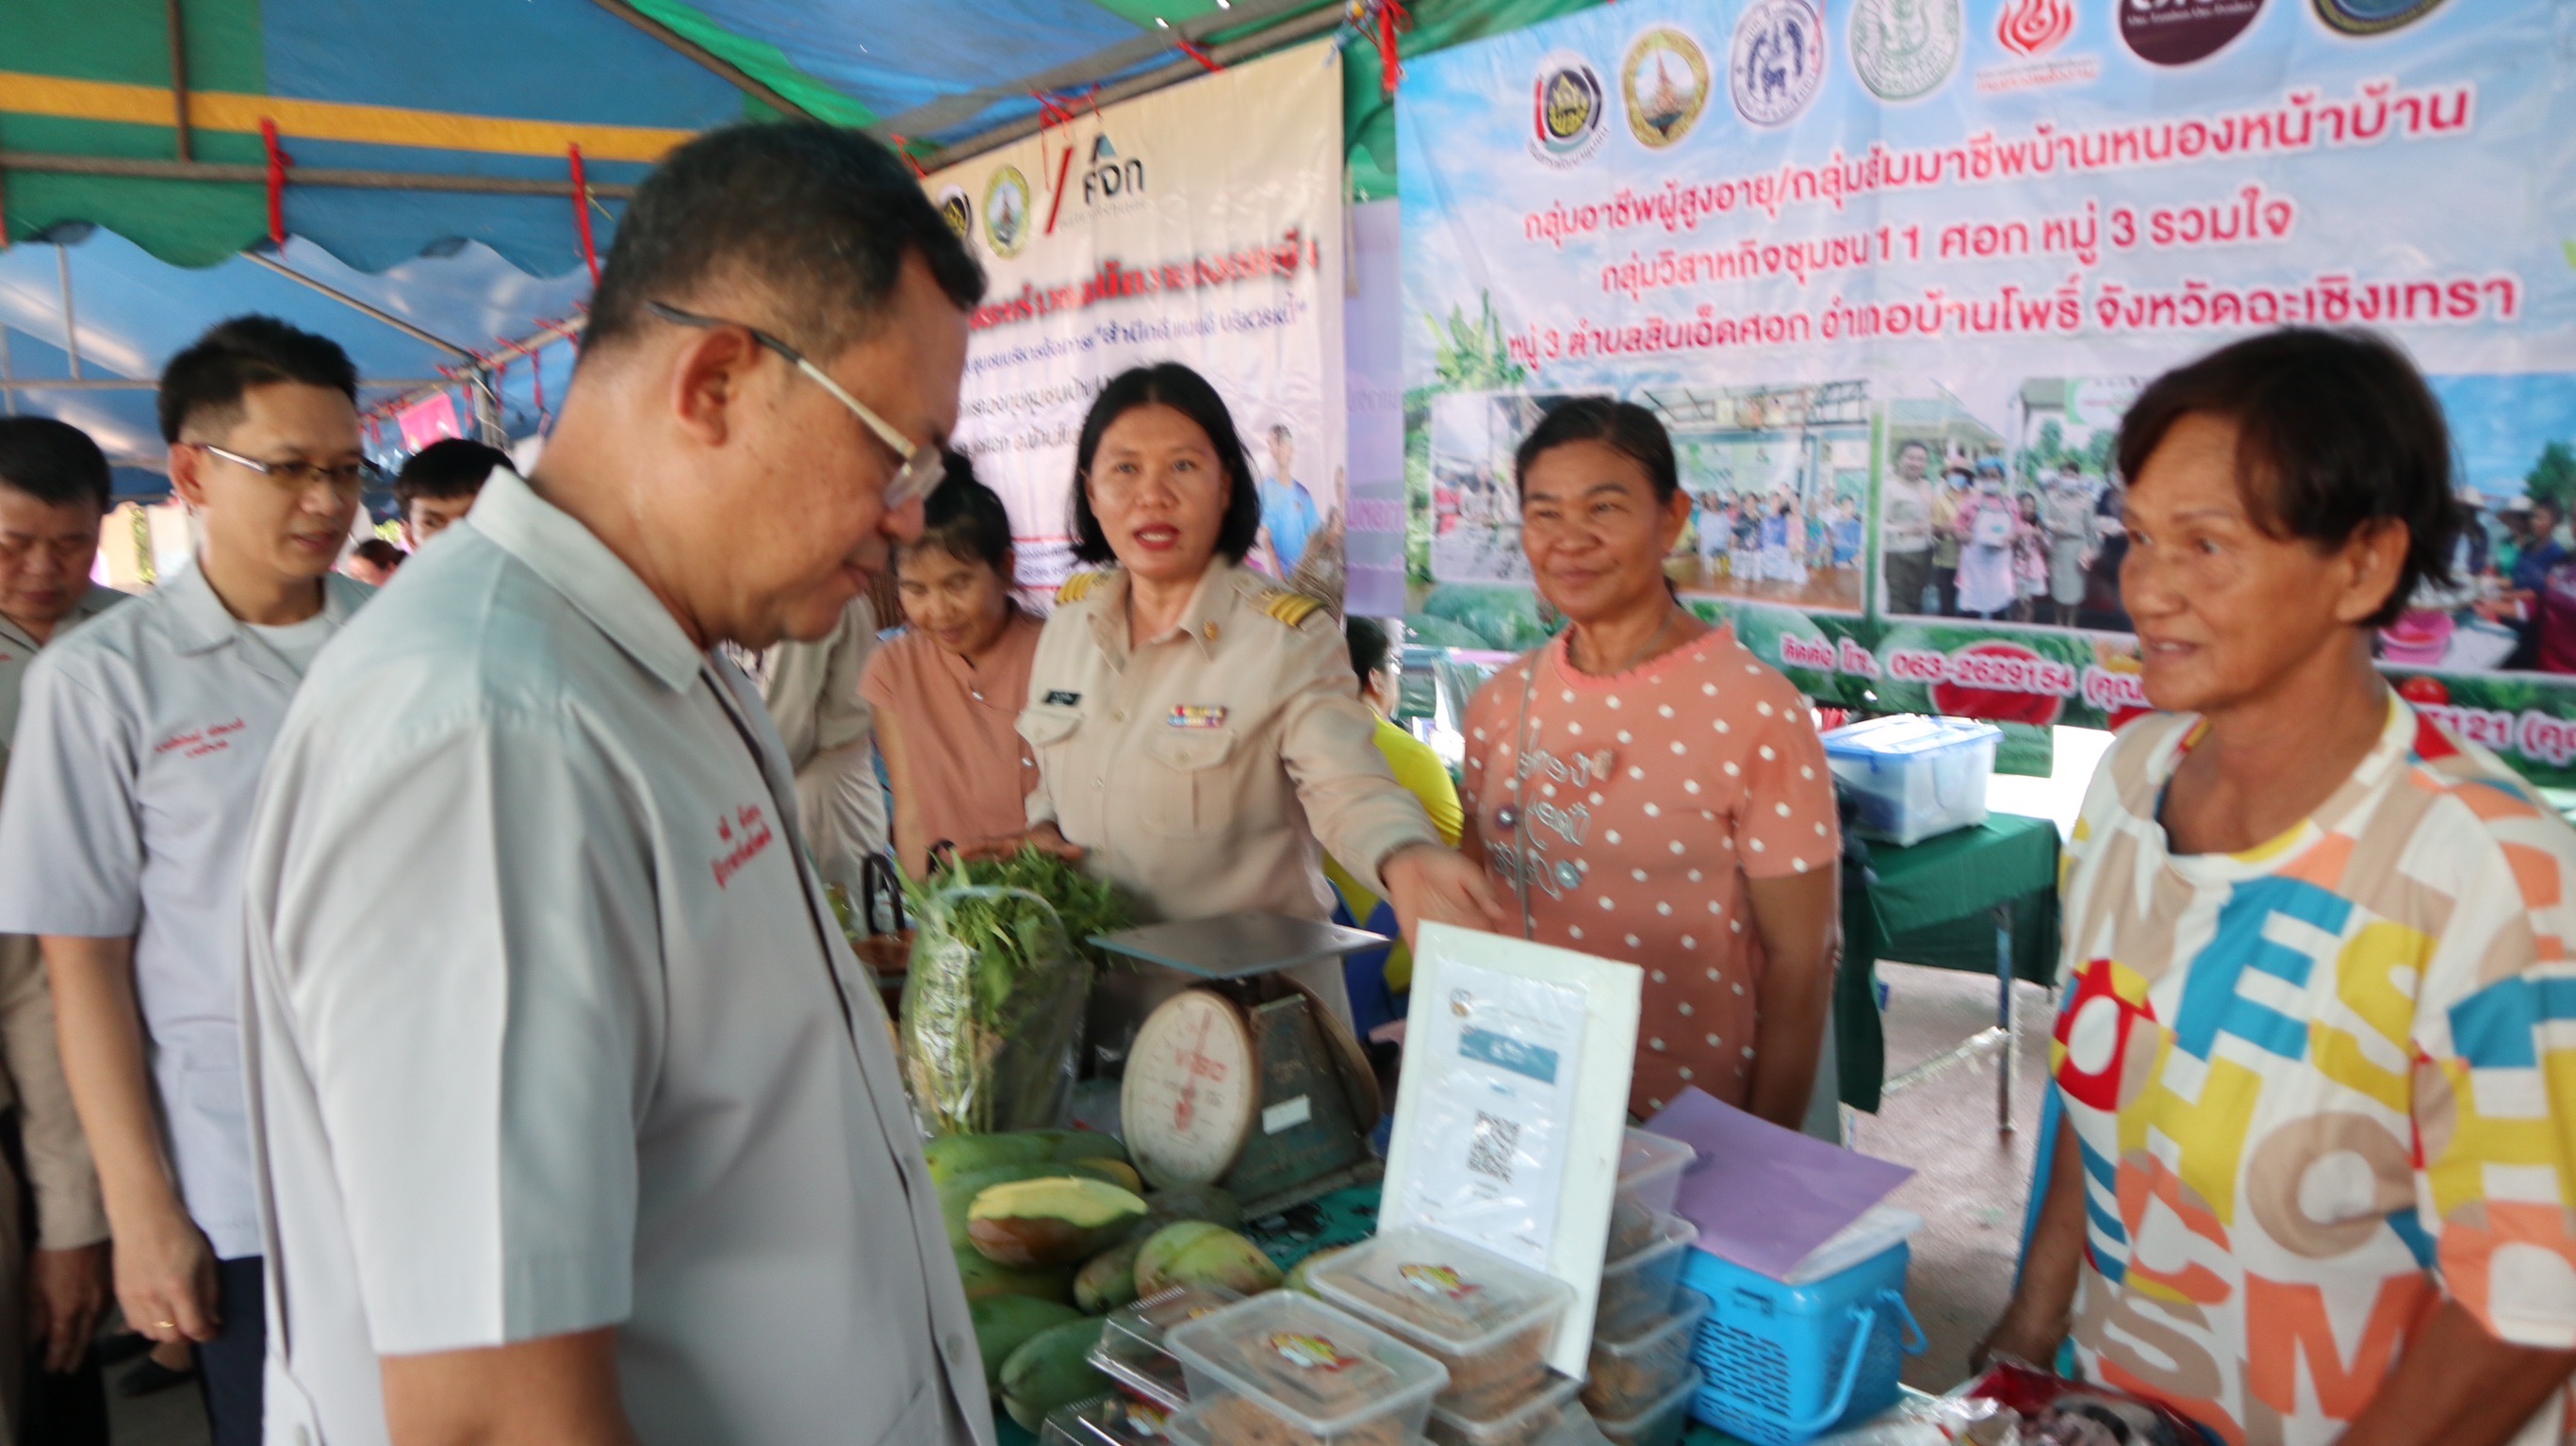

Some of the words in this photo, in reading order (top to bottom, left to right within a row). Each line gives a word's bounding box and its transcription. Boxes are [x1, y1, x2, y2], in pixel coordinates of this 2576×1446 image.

[1939, 221, 2029, 259] ศอก
[2043, 202, 2098, 267] หมู่
[2110, 208, 2137, 247] 3
[2149, 186, 2293, 244] รวมใจ
[1544, 328, 1561, 360] 3
[2094, 274, 2517, 330] จังหวัดฉะเชิงเทรา
[1891, 653, 2075, 690] 063-2629154
